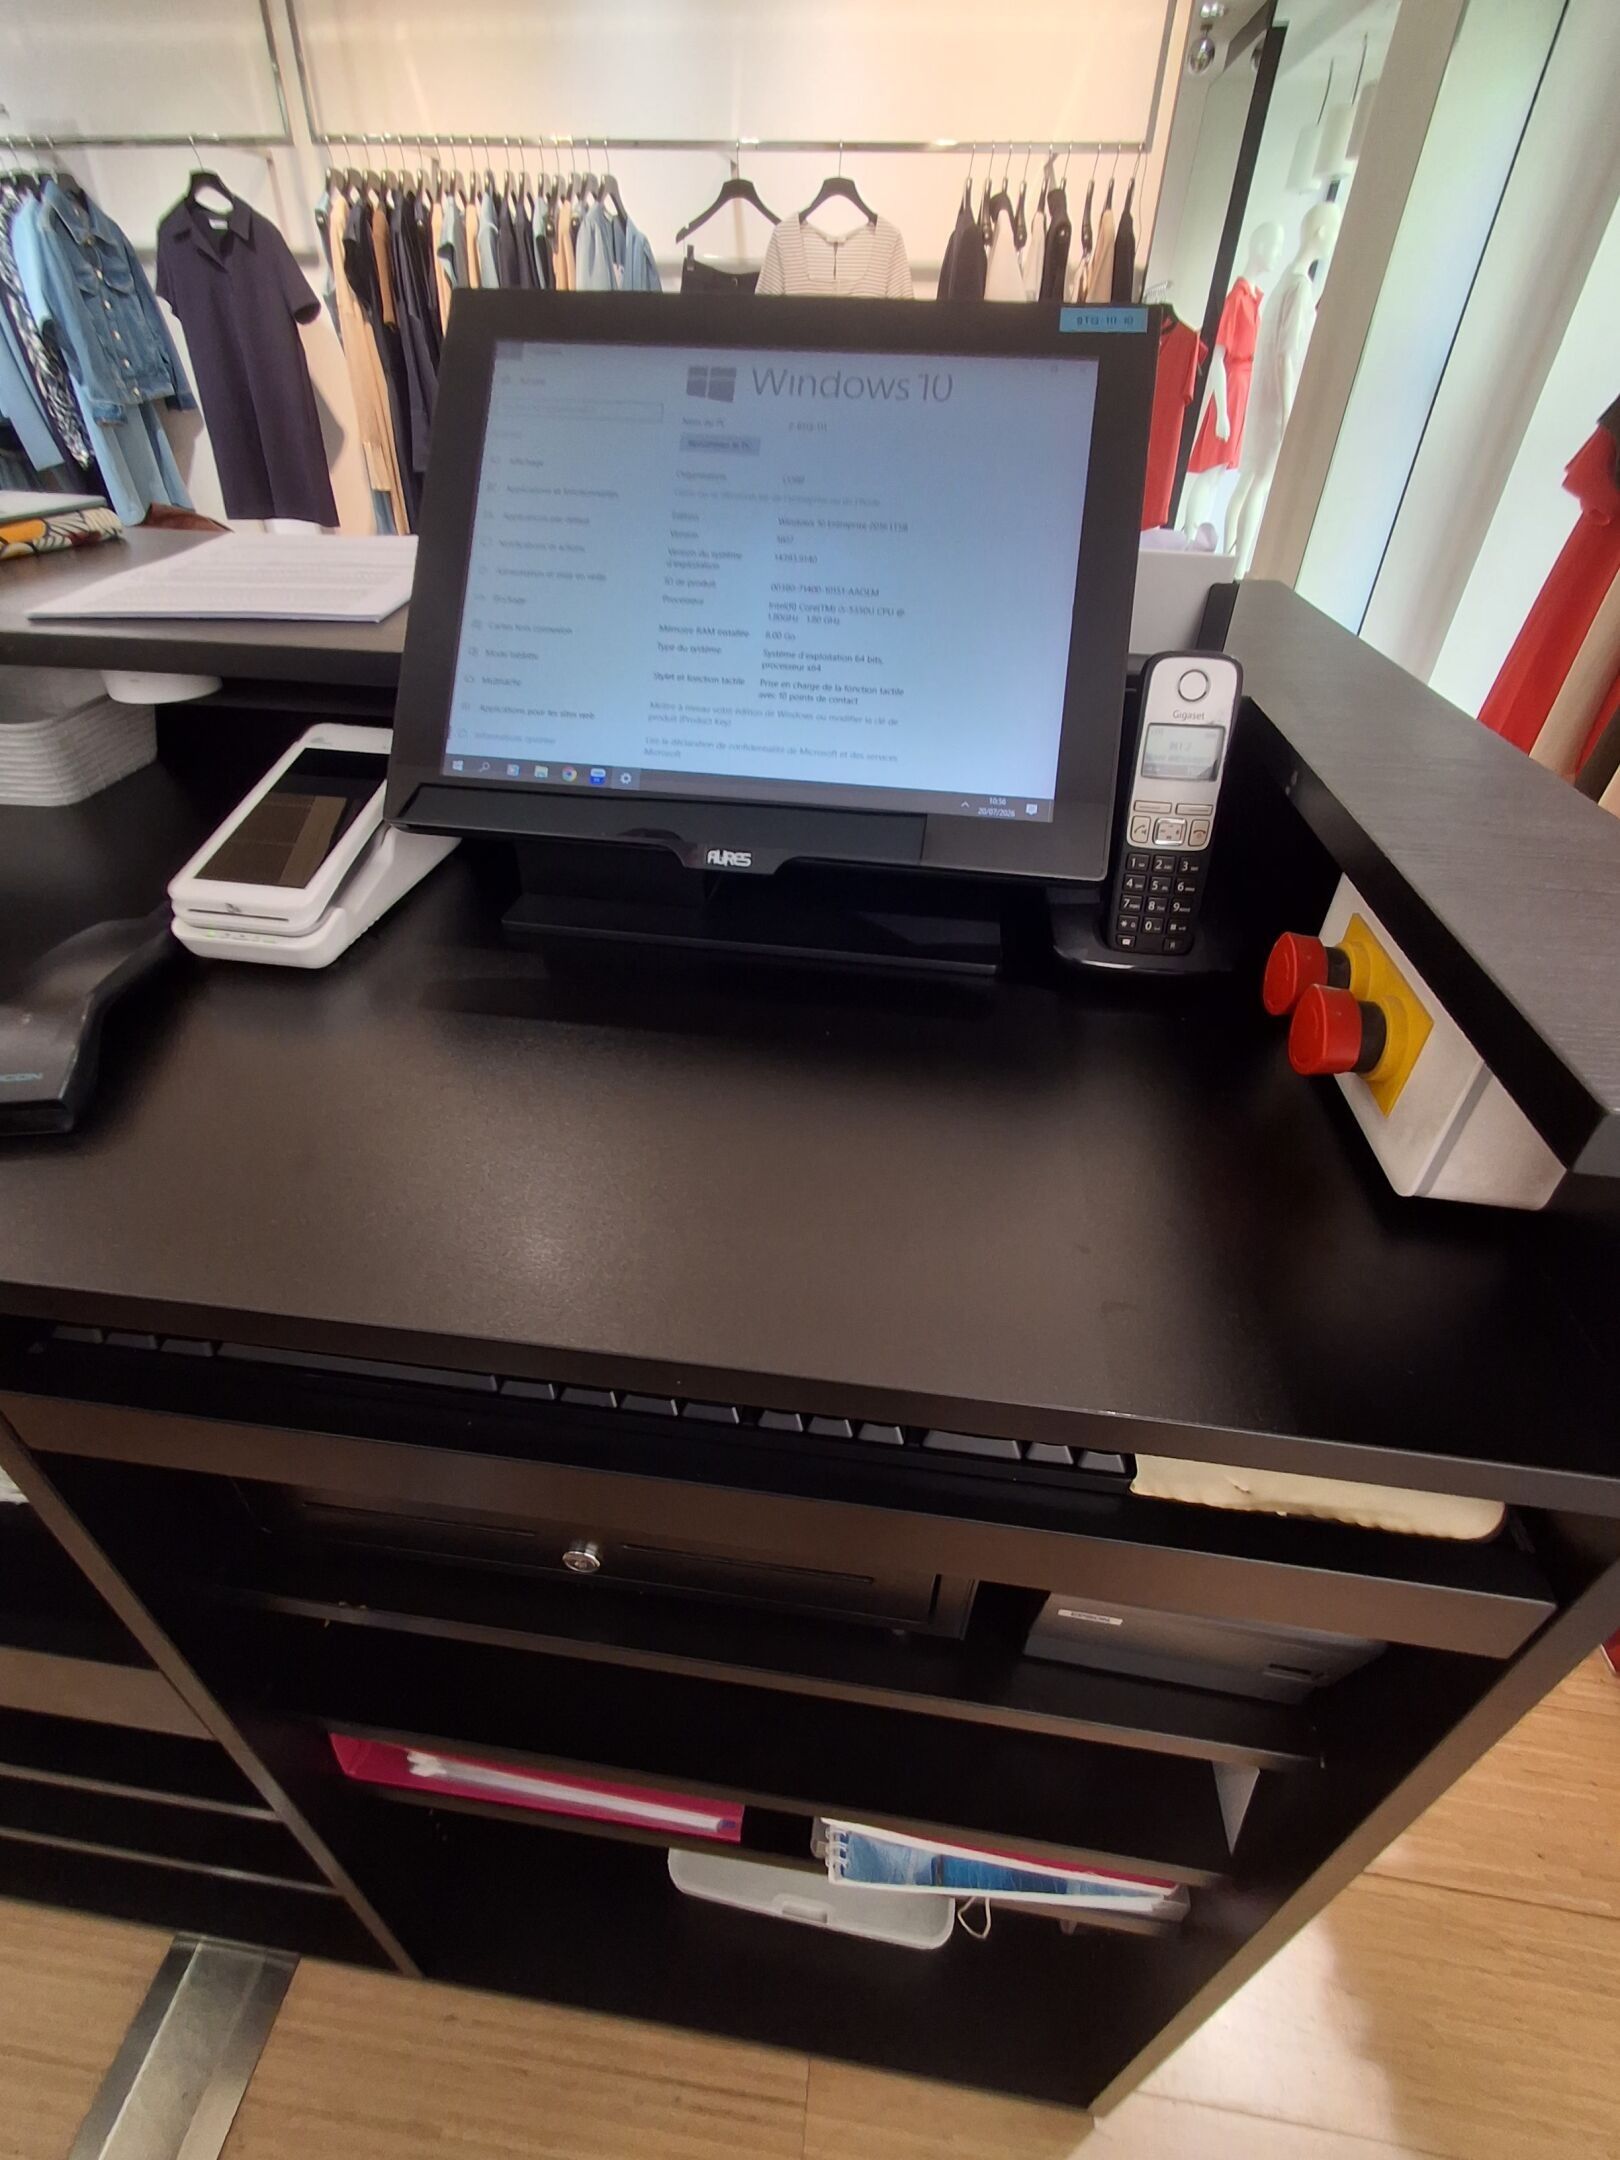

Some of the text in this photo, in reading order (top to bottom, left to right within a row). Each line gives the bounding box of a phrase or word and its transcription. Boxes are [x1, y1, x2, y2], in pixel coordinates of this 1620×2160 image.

[752, 368, 952, 401] Windows 10
[763, 649, 795, 658] Système
[854, 654, 864, 662] 64
[792, 681, 819, 691] charge
[821, 683, 832, 691] de
[834, 684, 841, 692] la
[843, 684, 877, 693] fonction
[879, 687, 904, 695] tactile
[778, 691, 787, 699] 10
[815, 694, 826, 702] de
[777, 710, 813, 719] Windows
[1172, 709, 1205, 722] Gigaset
[707, 849, 752, 868] AURES
[1155, 860, 1164, 870] 2
[1182, 861, 1189, 872] 3
[1126, 878, 1134, 888] 4
[1151, 880, 1160, 891] 5
[1177, 882, 1185, 892] 6
[1123, 898, 1131, 909] 7
[1148, 901, 1156, 911] 8
[1173, 902, 1181, 913] 9
[1145, 920, 1153, 931] 0
